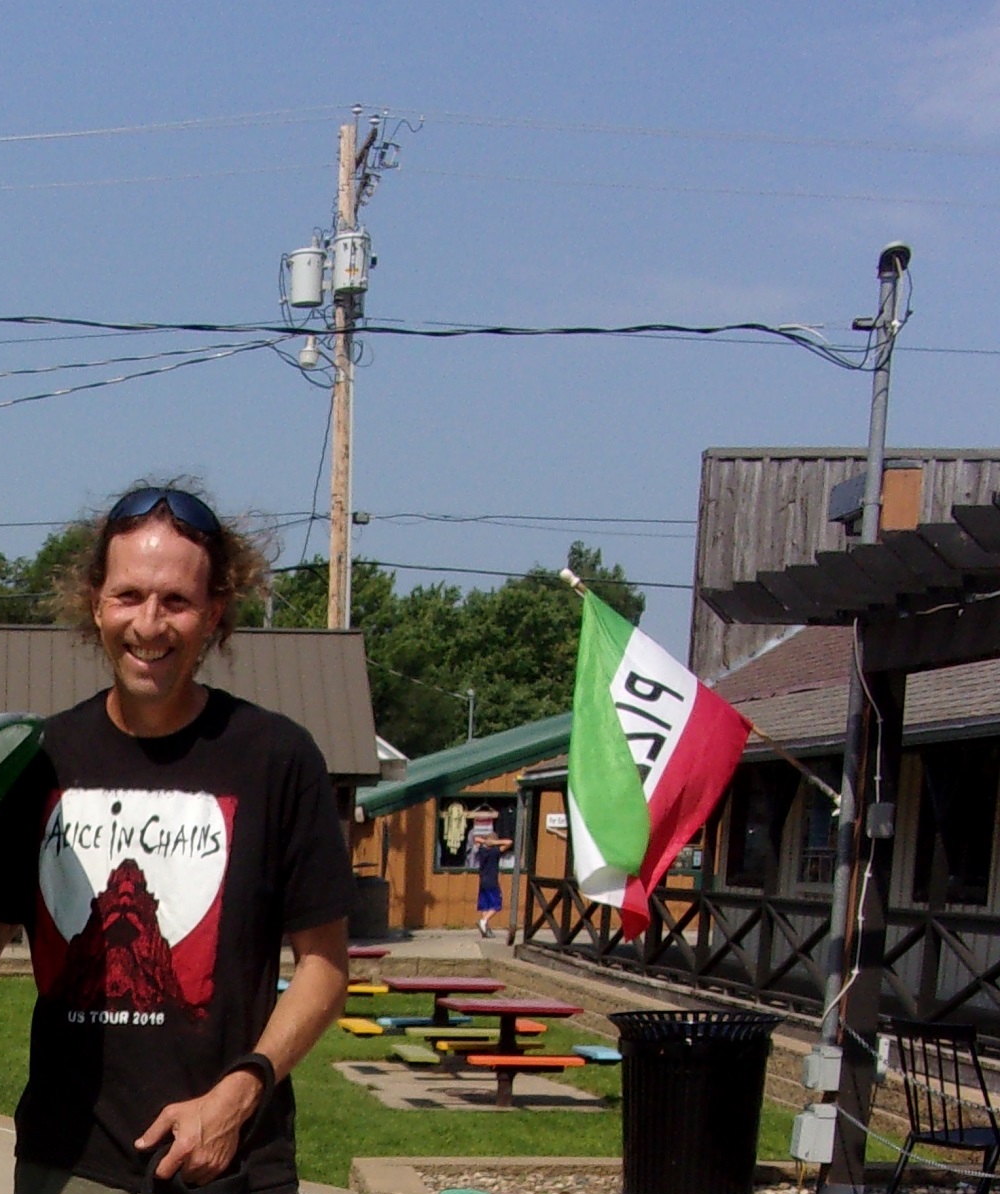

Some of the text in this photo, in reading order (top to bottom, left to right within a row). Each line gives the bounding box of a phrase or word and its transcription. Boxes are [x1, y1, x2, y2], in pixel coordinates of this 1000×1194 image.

[45, 812, 103, 856] ALICE
[139, 815, 222, 857] CHAINS
[67, 1010, 85, 1024] US
[89, 1010, 129, 1025] TOUR
